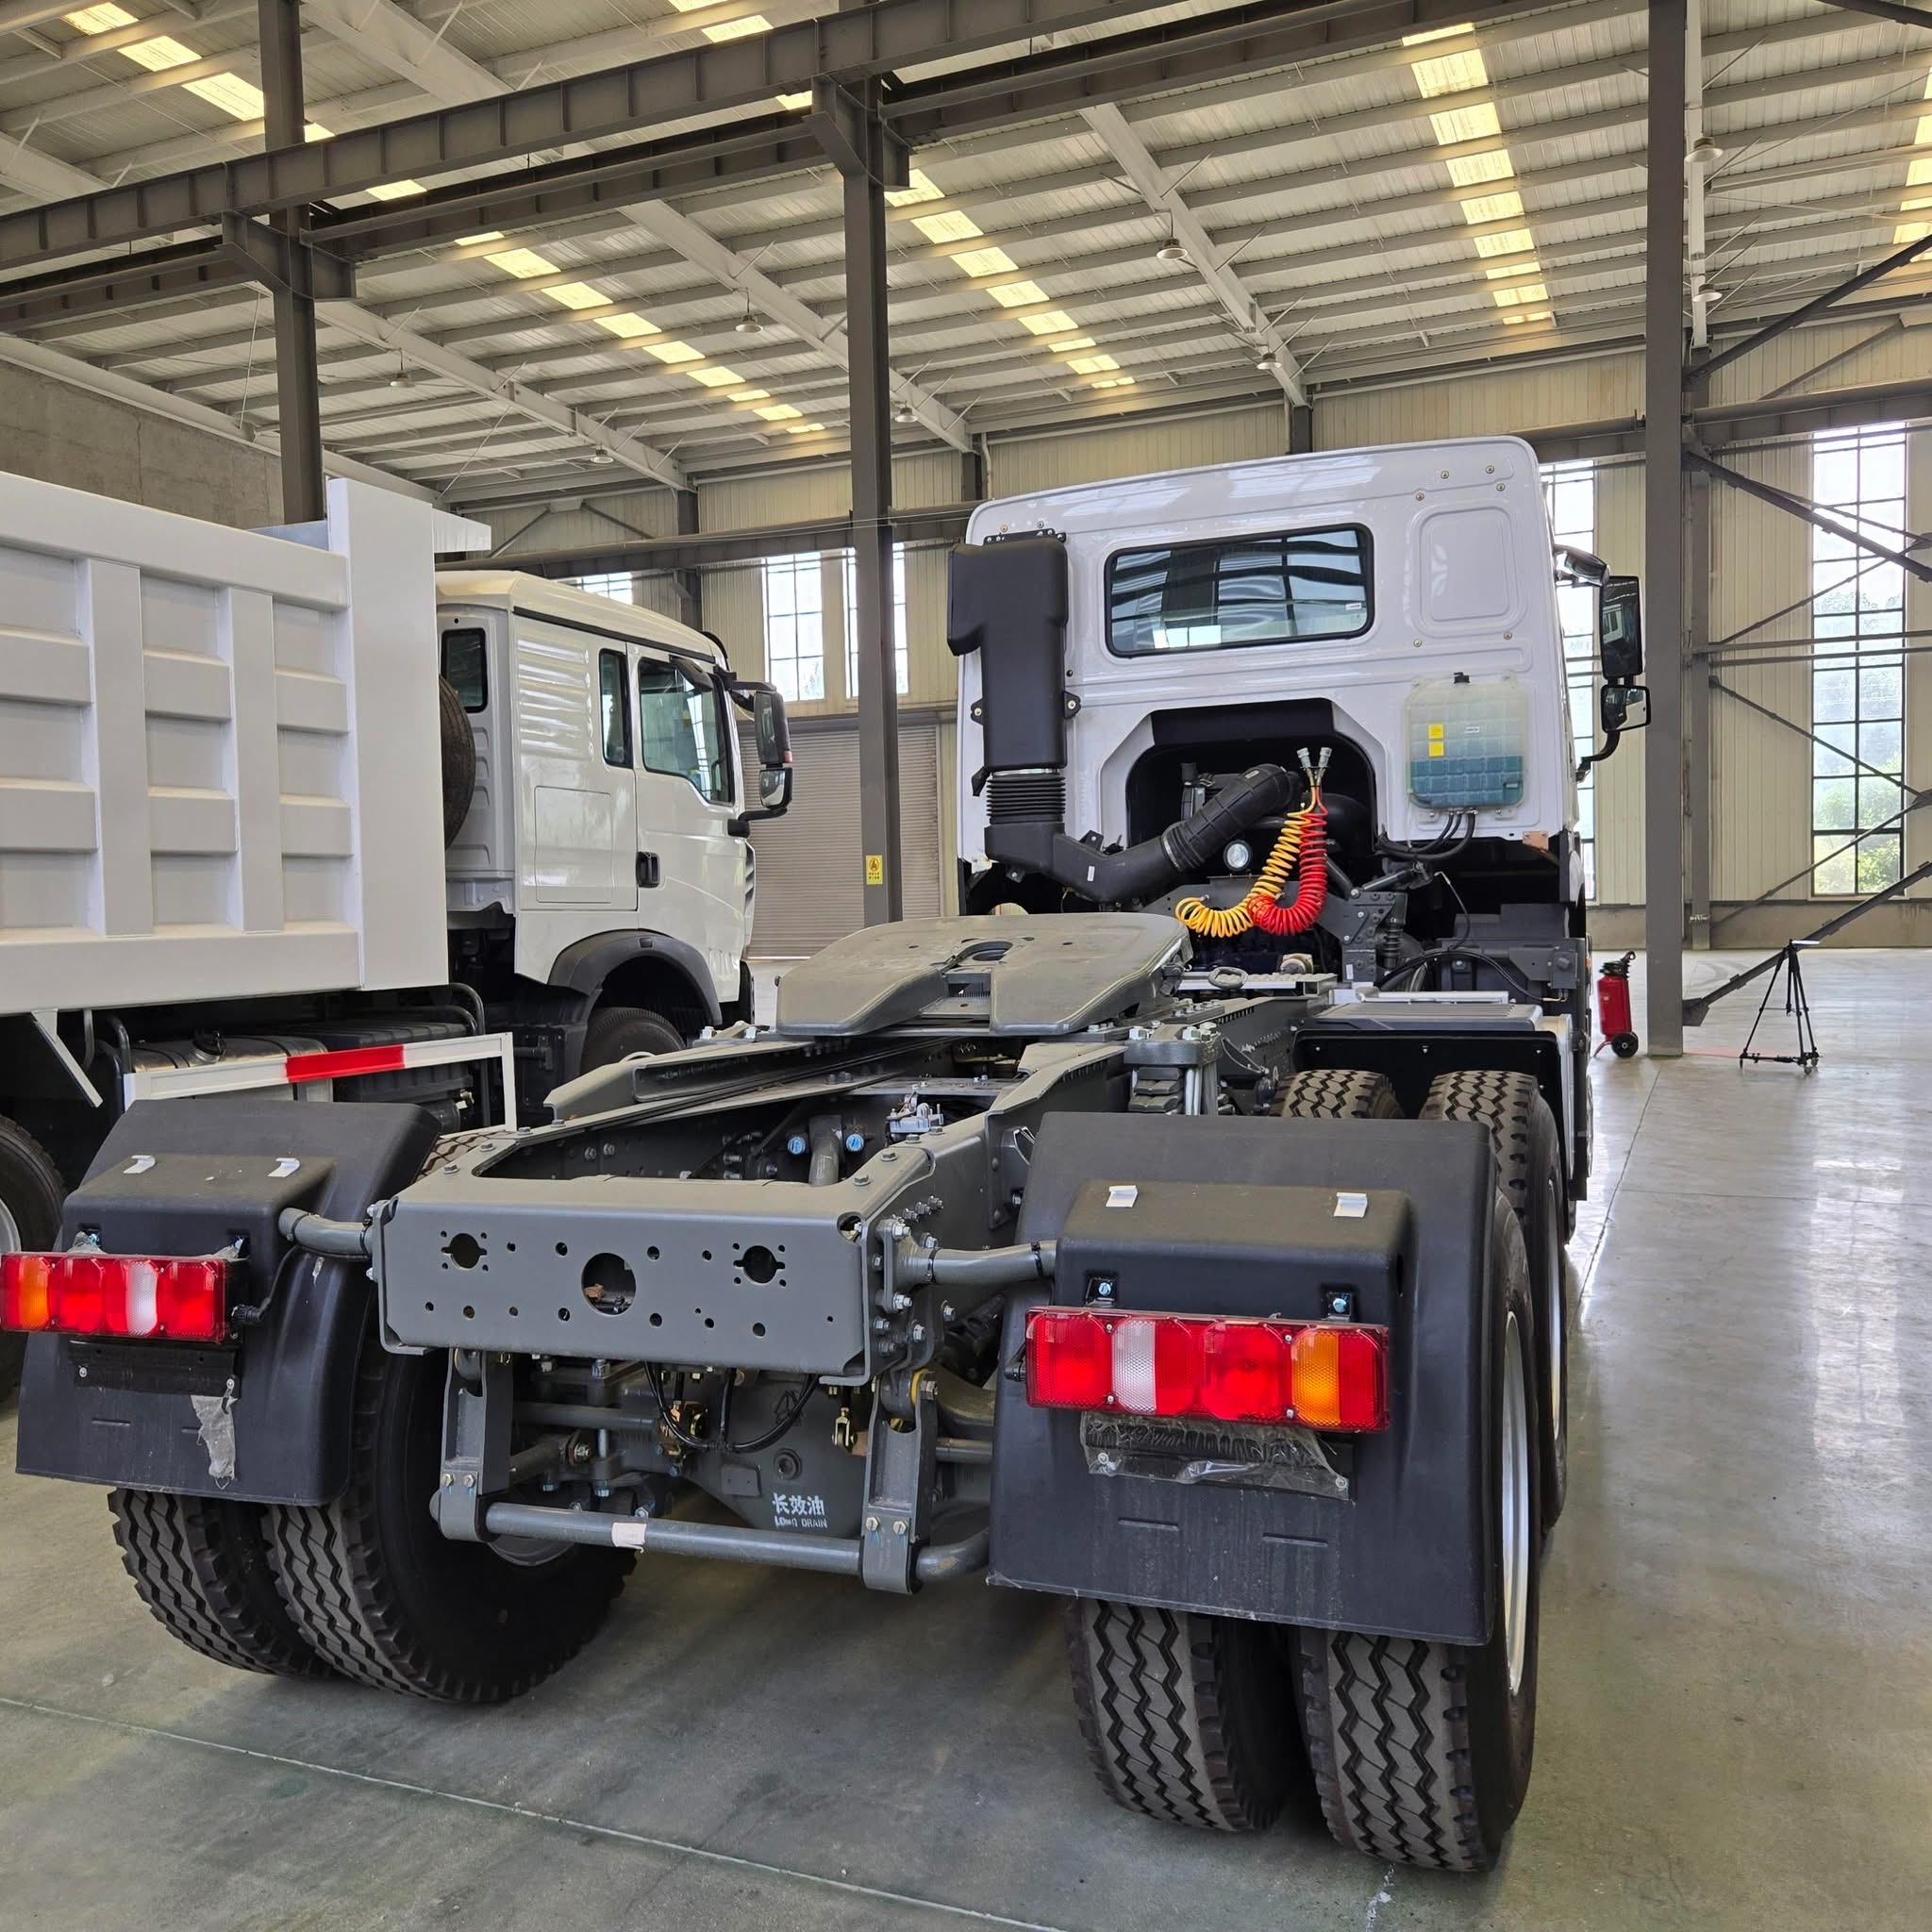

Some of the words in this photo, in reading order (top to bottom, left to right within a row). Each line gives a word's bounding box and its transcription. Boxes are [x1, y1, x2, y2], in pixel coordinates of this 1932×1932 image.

[772, 1492, 825, 1516] 长效油
[801, 1518, 828, 1528] DRAIN
